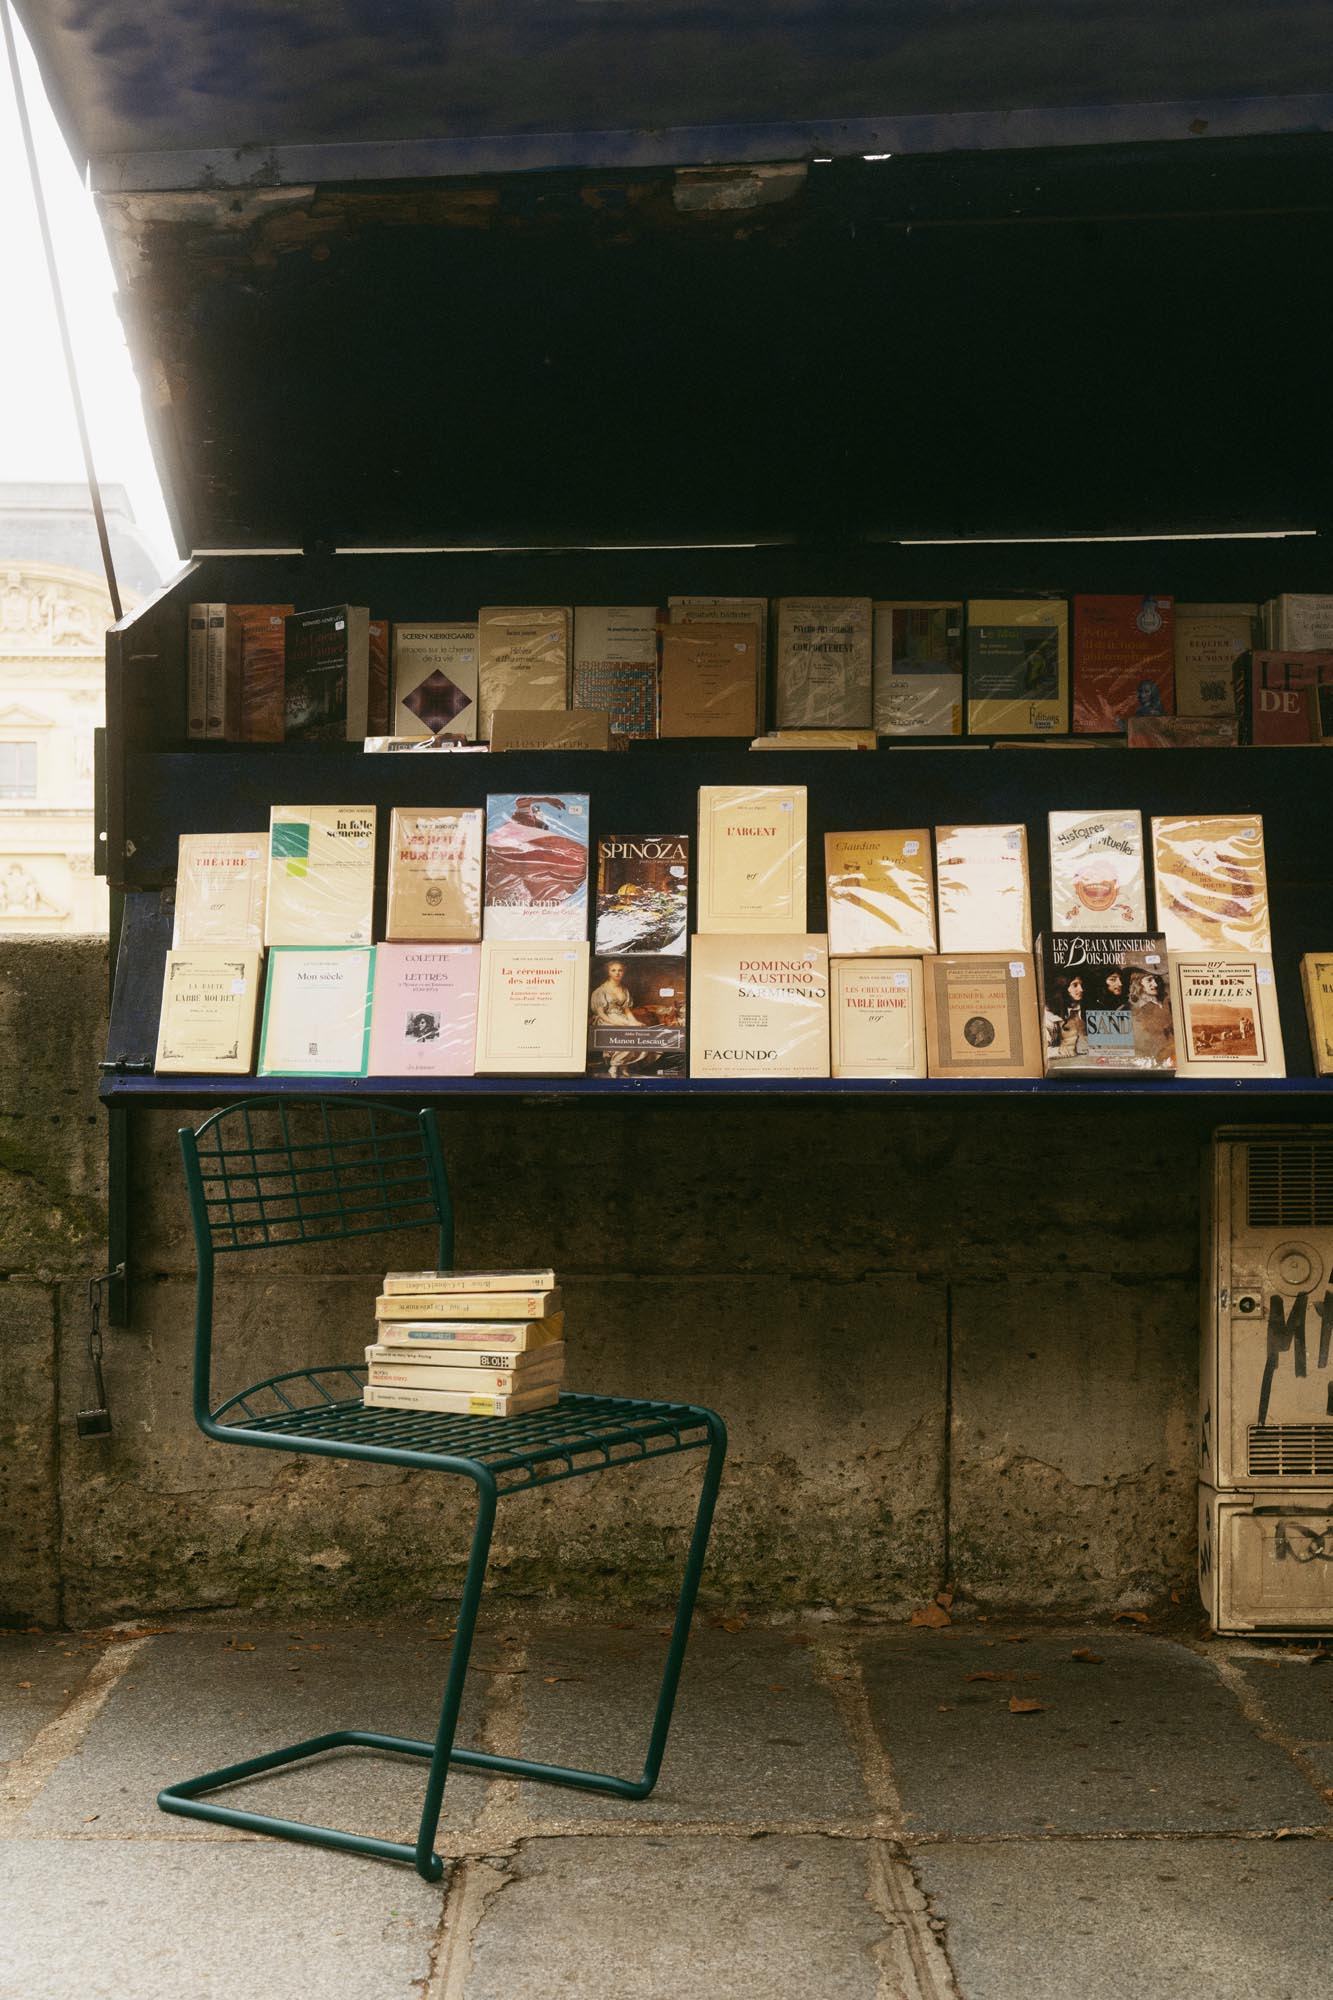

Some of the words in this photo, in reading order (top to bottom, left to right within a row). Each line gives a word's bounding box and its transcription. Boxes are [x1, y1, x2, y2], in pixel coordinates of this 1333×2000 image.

[429, 633, 475, 641] KIERKEGAARD
[1259, 690, 1300, 714] DE
[337, 820, 347, 830] la
[350, 820, 373, 830] folle
[326, 830, 373, 838] semence
[727, 827, 777, 837] L'ARGENT
[1057, 824, 1105, 845] Histoires
[601, 842, 687, 859] SPINOZA
[835, 841, 881, 852] Claudine
[1052, 938, 1069, 952] LES
[1109, 939, 1156, 952] MESSIEURS
[405, 954, 449, 963] COLETTE
[1053, 952, 1066, 965] DE
[739, 961, 813, 971] DOMINGO
[1208, 960, 1226, 969] nrf
[297, 972, 319, 981] Mon
[502, 967, 513, 976] La
[405, 972, 449, 982] LETTRES
[508, 976, 523, 985] des
[526, 976, 555, 985] adieux
[739, 973, 814, 984] FAUSTINO
[1192, 978, 1214, 986] ROI
[1220, 978, 1245, 986] DES
[845, 985, 860, 994] LES
[861, 986, 906, 994] CHEVALIERS
[1186, 988, 1253, 997] ABEILLES
[846, 998, 875, 1009] TABLE
[877, 998, 906, 1009] RONDE
[1087, 1015, 1133, 1035] SAND
[609, 1037, 635, 1045] Manon
[637, 1036, 665, 1046] Lescaut
[703, 1049, 778, 1061] FACUNDO
